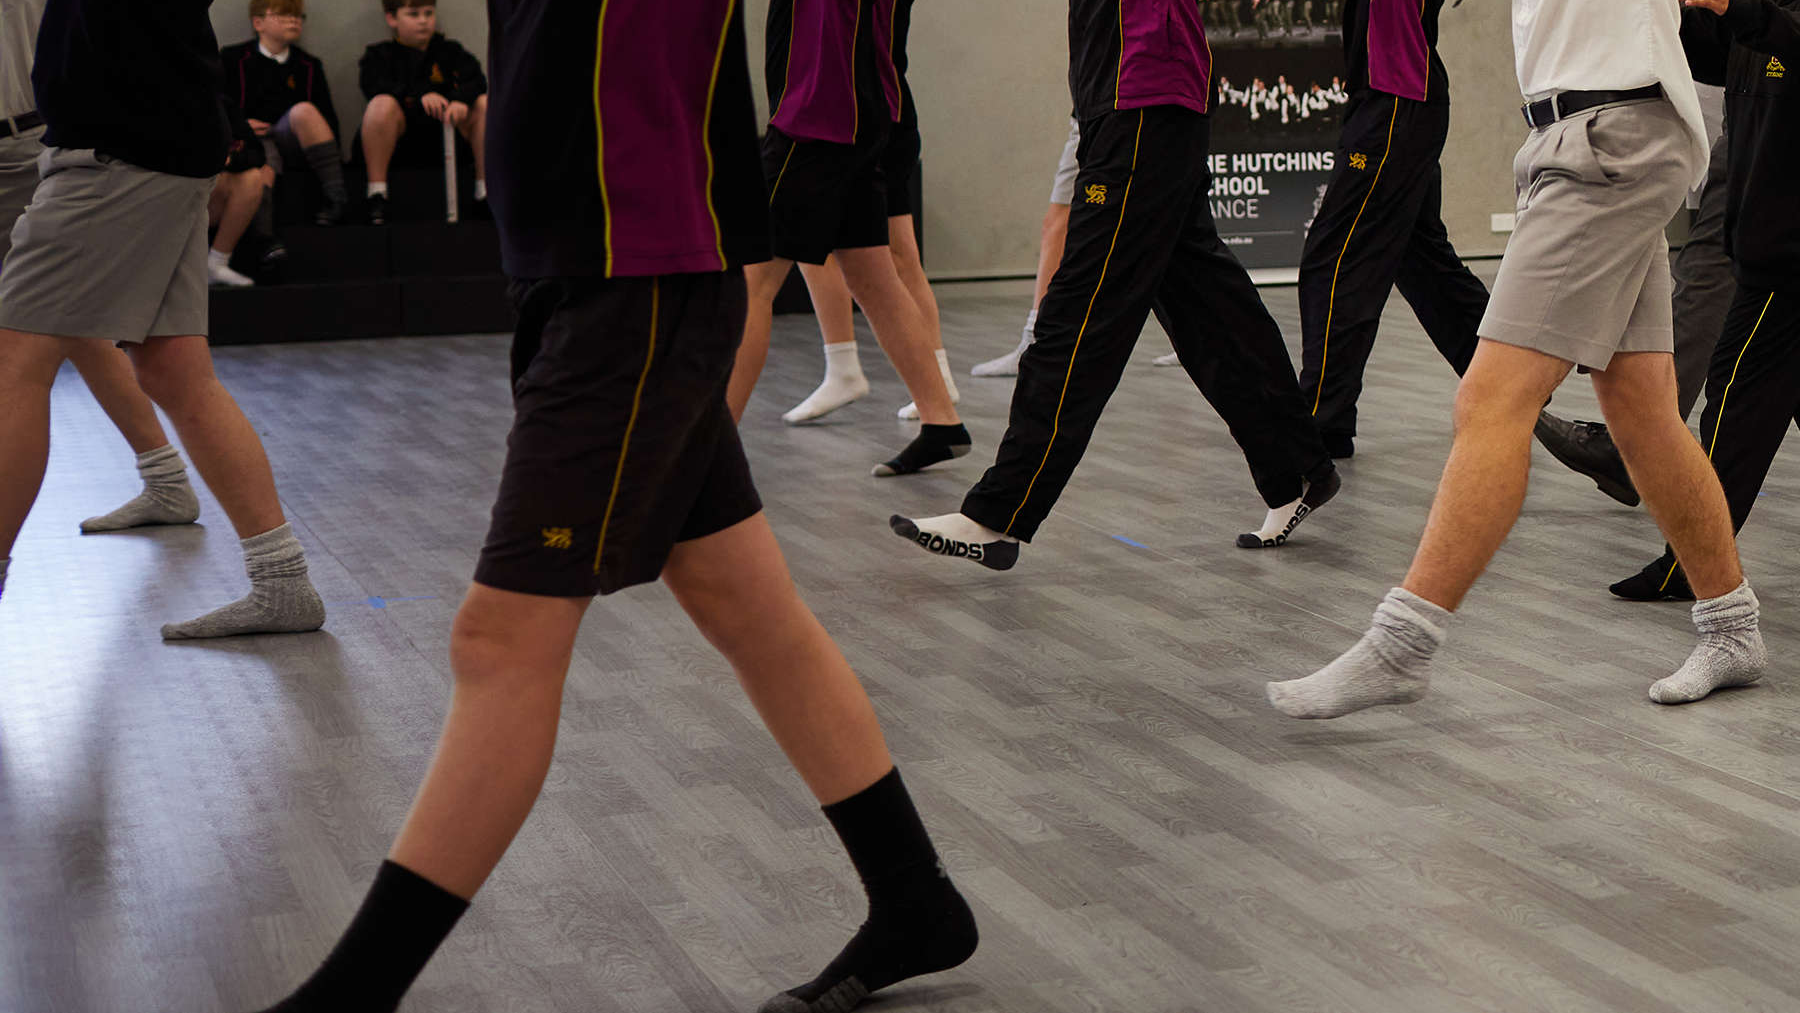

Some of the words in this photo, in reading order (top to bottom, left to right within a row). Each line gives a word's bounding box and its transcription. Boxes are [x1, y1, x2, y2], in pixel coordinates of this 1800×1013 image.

[1232, 151, 1335, 173] HUTCHINS
[1207, 175, 1270, 197] HOOL
[1209, 198, 1259, 219] NCE
[917, 531, 982, 559] BONDS
